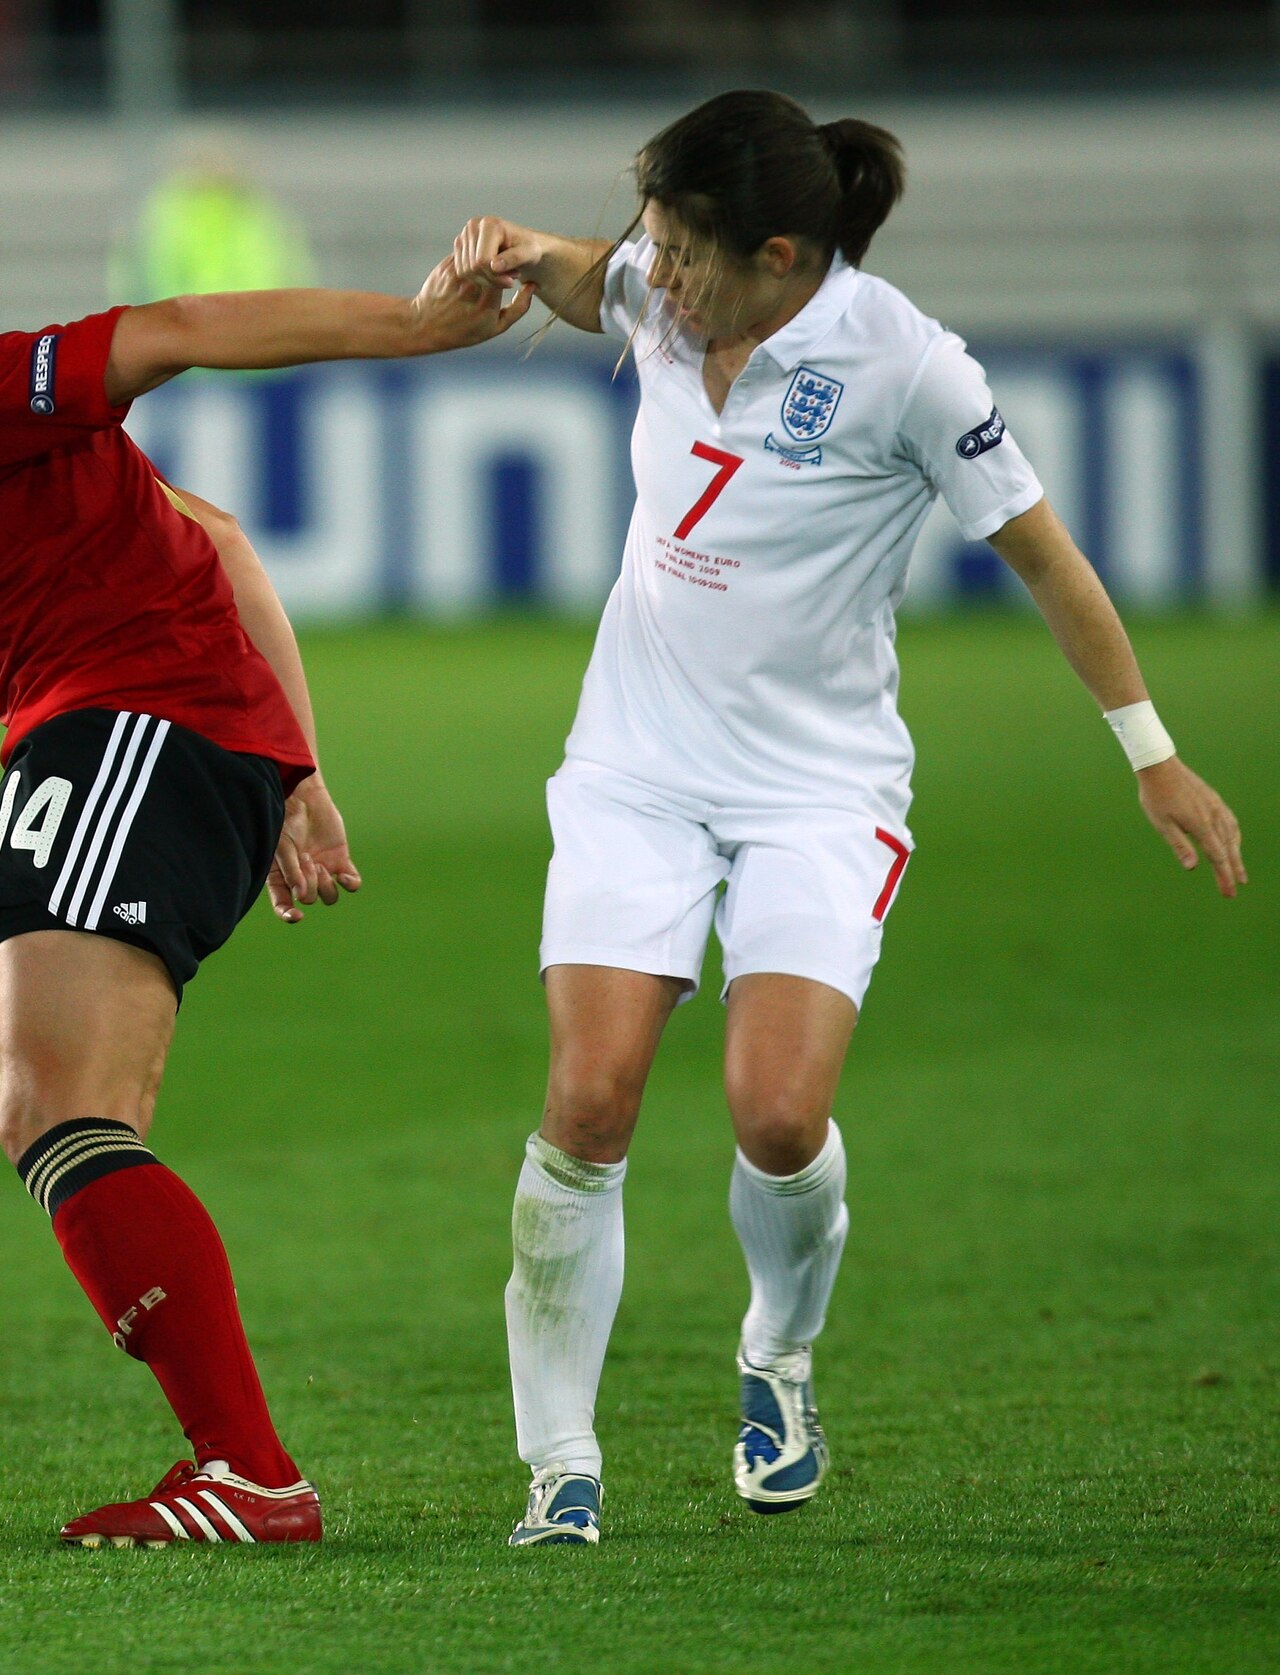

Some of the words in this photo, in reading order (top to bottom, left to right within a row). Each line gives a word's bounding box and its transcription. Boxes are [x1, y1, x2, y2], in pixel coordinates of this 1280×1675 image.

[673, 440, 745, 541] 7
[698, 564, 720, 576] 2009
[714, 556, 741, 569] EURO
[872, 826, 910, 922] 7
